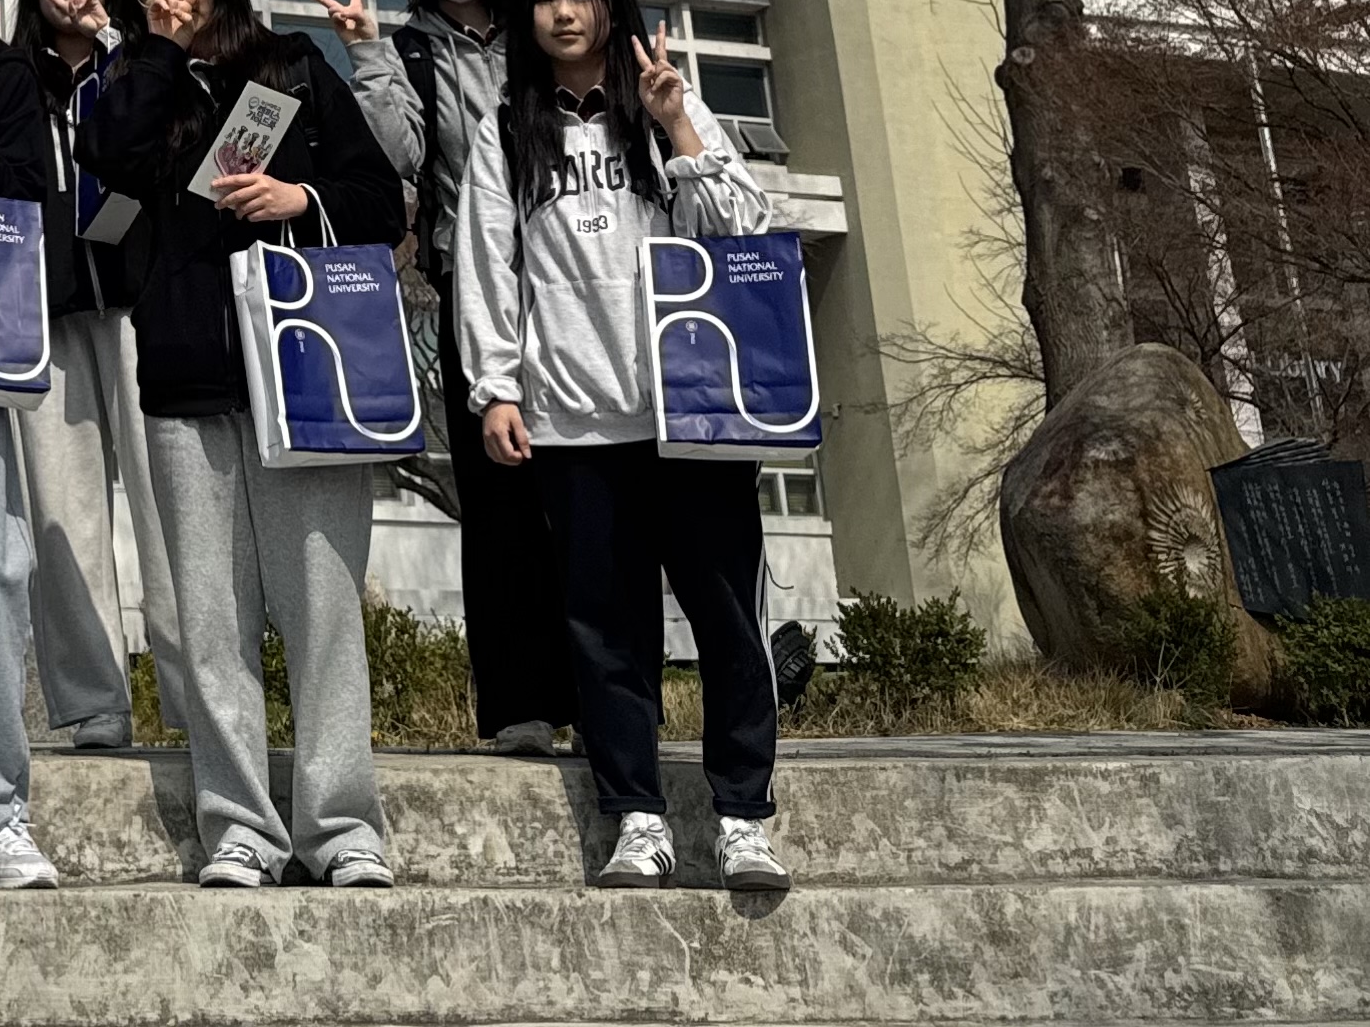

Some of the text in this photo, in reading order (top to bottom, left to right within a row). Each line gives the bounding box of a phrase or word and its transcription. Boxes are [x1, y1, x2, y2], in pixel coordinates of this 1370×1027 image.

[575, 214, 609, 234] 1993
[726, 252, 760, 263] PUSAN
[324, 262, 356, 273] PUSAN
[728, 261, 778, 273] NATIONAL
[326, 272, 375, 283] NATIONAL
[728, 271, 784, 284] UNIVERSITY
[328, 282, 380, 294] UNIVERSITY
[1267, 352, 1342, 384] Libry
